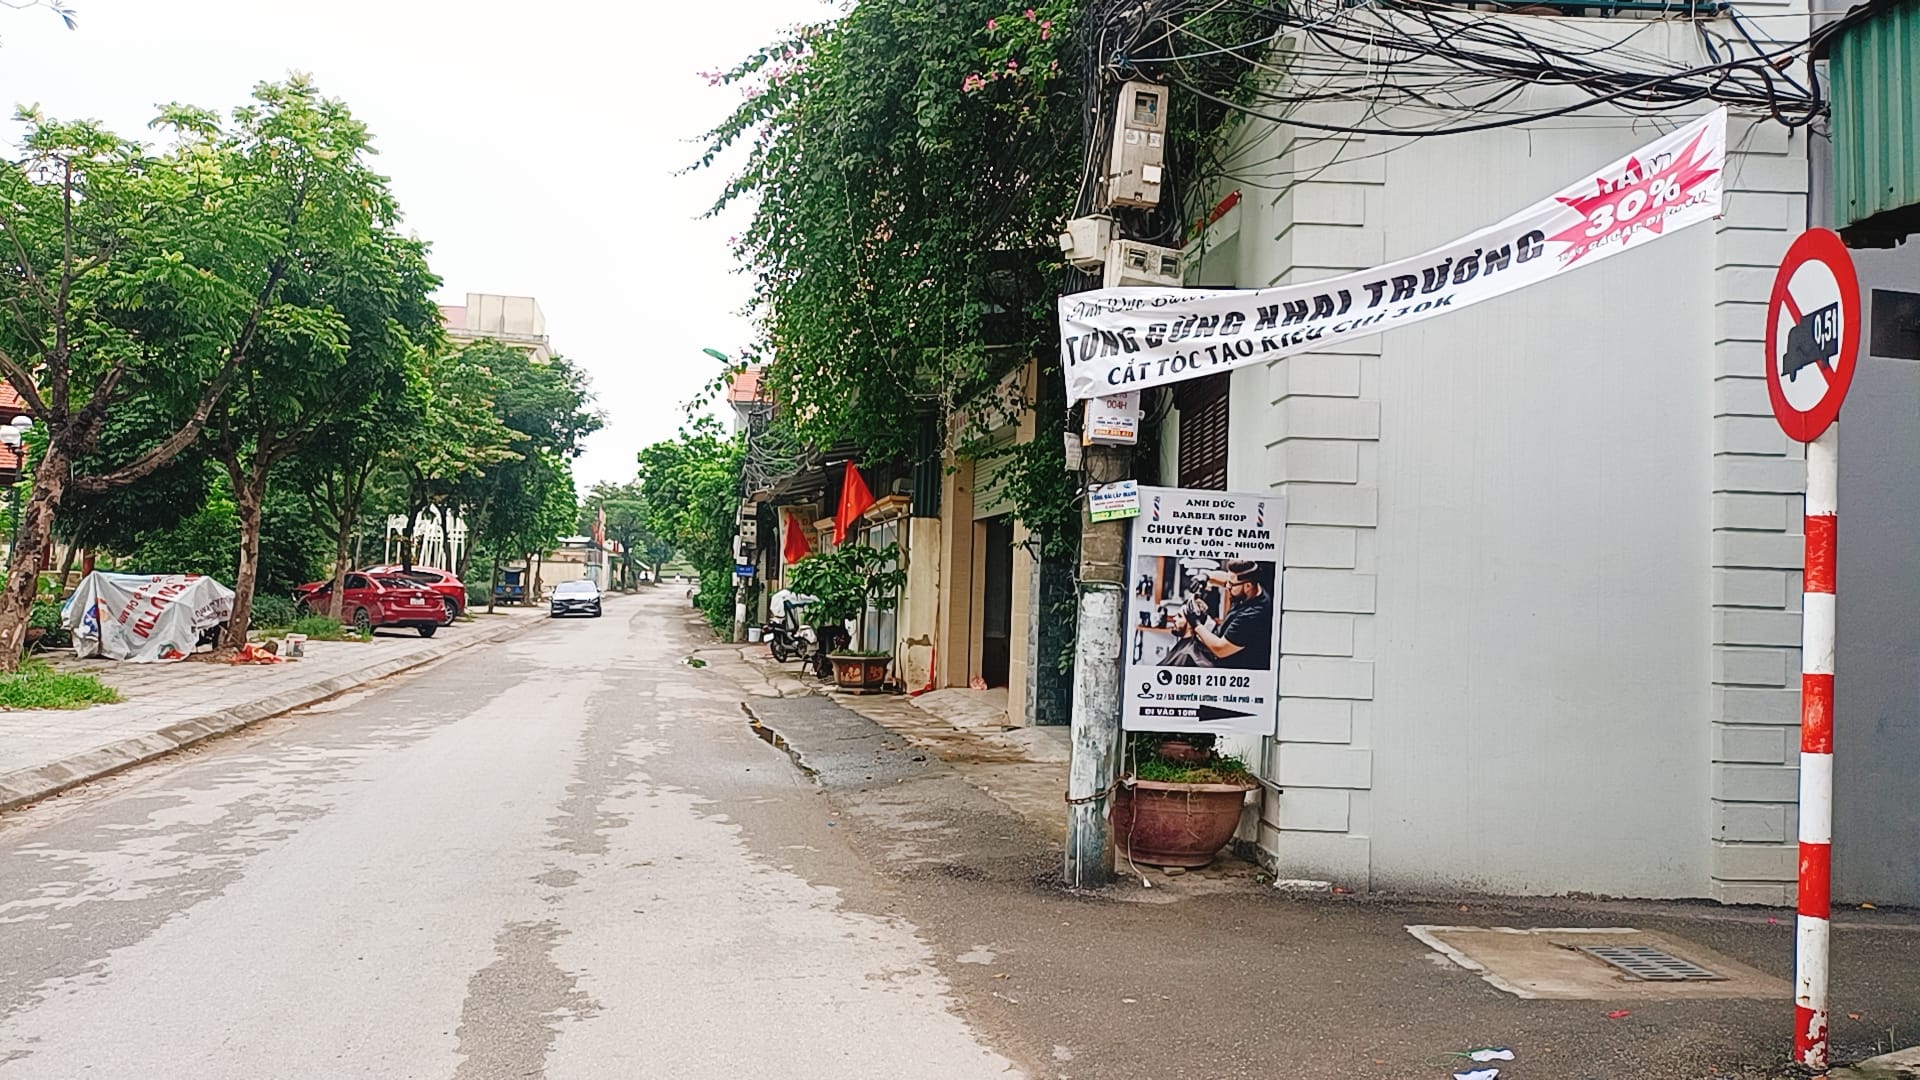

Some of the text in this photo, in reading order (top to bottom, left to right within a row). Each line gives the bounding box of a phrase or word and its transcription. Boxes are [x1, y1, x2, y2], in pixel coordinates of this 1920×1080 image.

[1584, 172, 1680, 237] 30%
[1107, 358, 1151, 385] CẮT
[1157, 351, 1202, 377] TÓC
[1186, 499, 1210, 507] ANH
[1172, 511, 1247, 522] BARBER SHOP
[1147, 523, 1270, 540] CHUYÊN TÓC NAM
[1223, 551, 1239, 559] TAI
[1175, 673, 1250, 688] 0981 210 202
